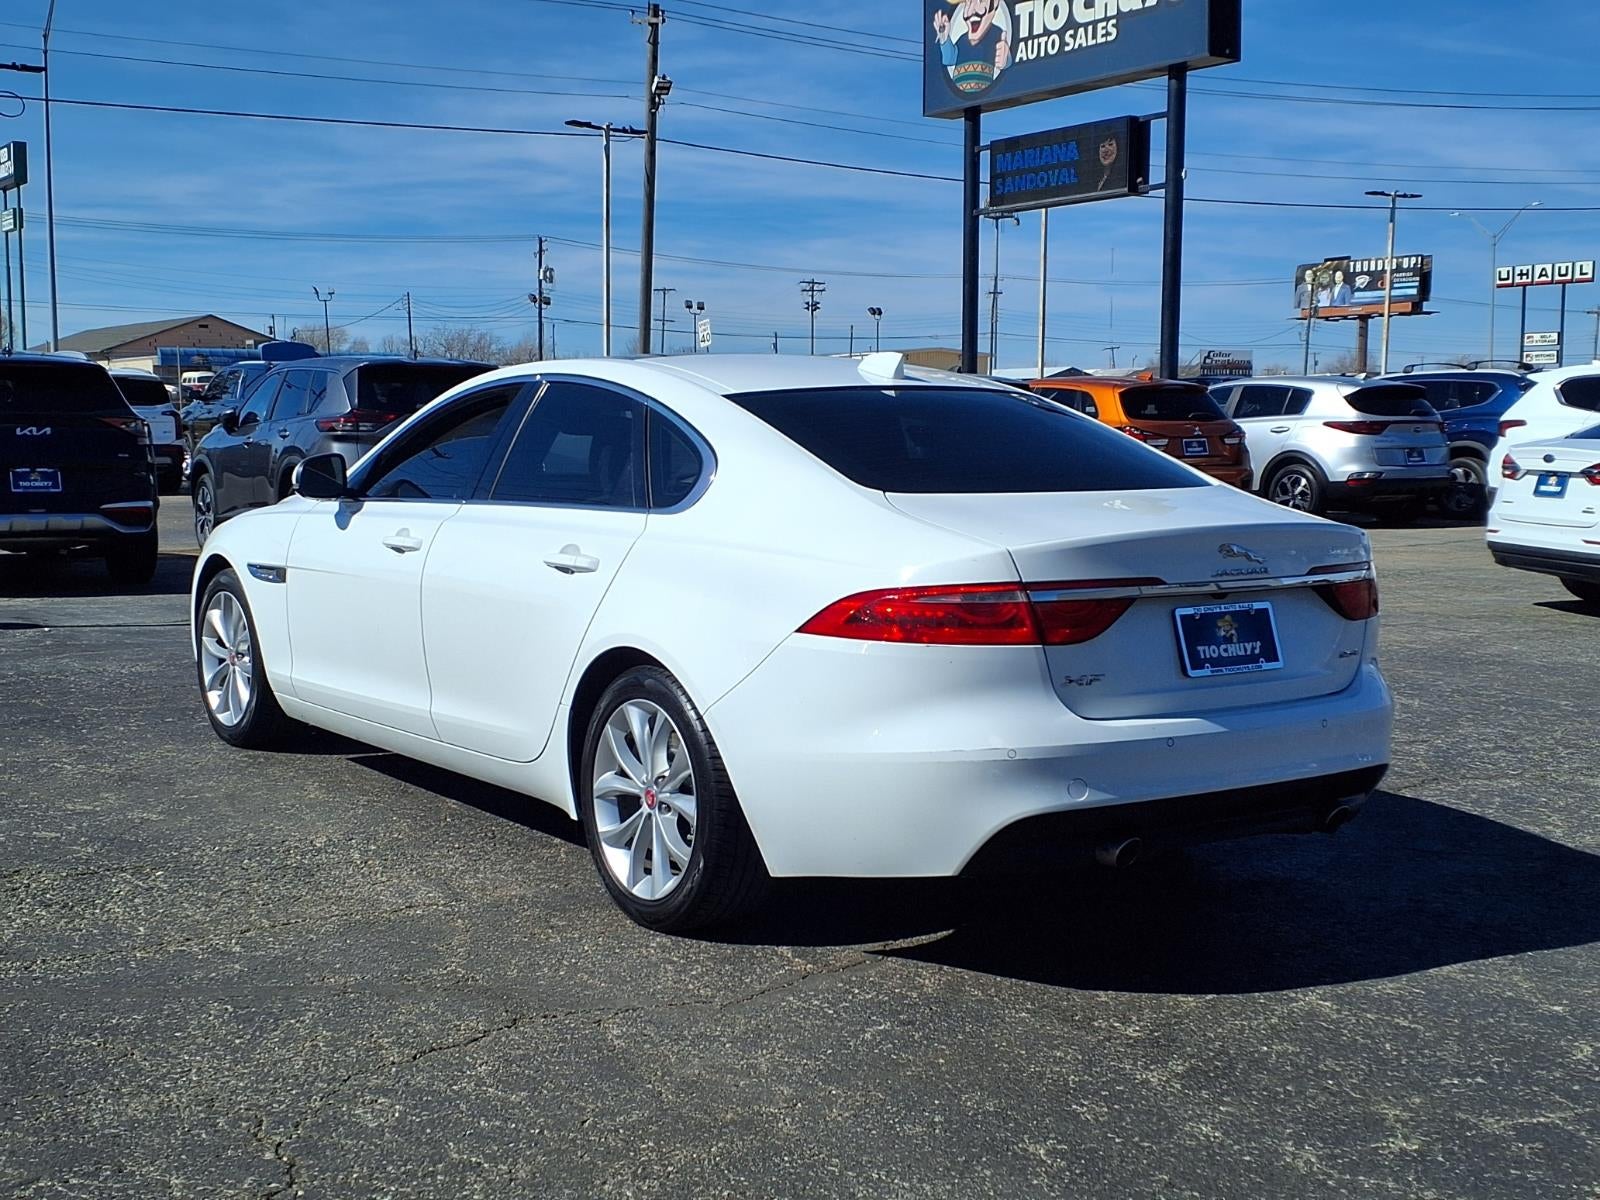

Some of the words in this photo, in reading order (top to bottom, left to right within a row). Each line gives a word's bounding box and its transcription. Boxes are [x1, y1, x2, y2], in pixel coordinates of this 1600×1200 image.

[1015, 0, 1070, 39] TIO
[1015, 33, 1060, 63] AUTO
[1064, 19, 1118, 52] SALES
[995, 141, 1079, 173] MARIANA
[995, 168, 1078, 195] SANDOVAL
[1402, 255, 1422, 269] UP!
[700, 332, 711, 343] 40
[1207, 350, 1232, 359] Color
[16, 426, 51, 435] KIA
[1210, 567, 1270, 578] JAGUAR
[1197, 645, 1219, 659] TIO
[1219, 641, 1262, 657] CHUY'S
